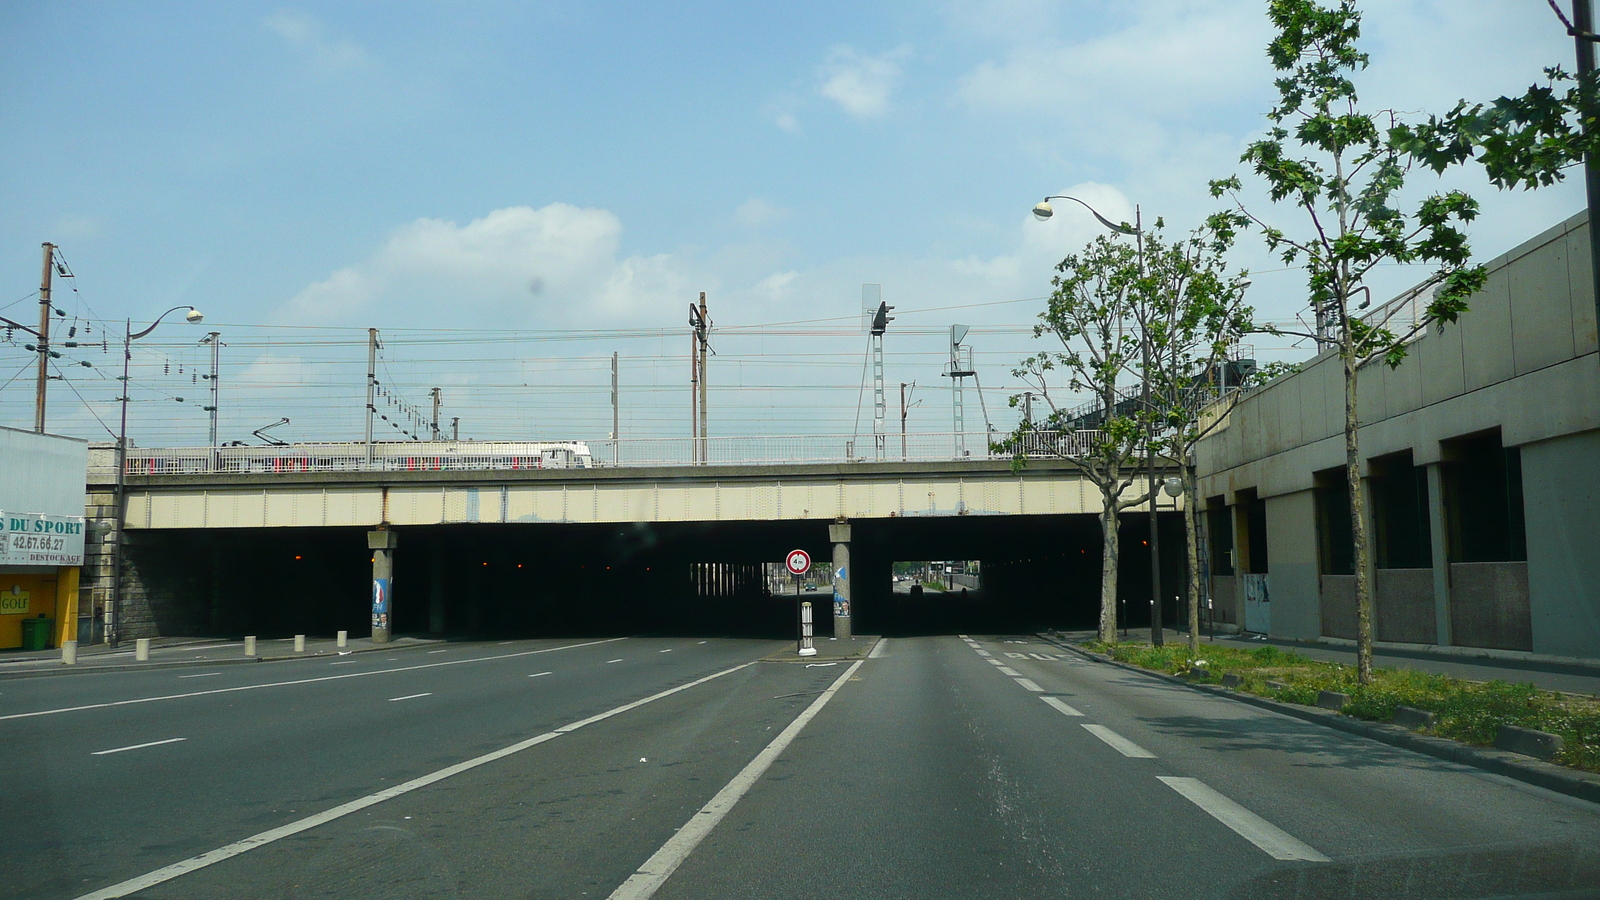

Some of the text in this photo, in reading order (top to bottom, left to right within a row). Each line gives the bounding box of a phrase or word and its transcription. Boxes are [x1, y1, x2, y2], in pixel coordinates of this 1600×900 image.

[10, 518, 30, 532] DU
[34, 519, 83, 534] SPORT
[30, 554, 81, 562] DESTOCKAGE
[2, 598, 28, 609] GOLF
